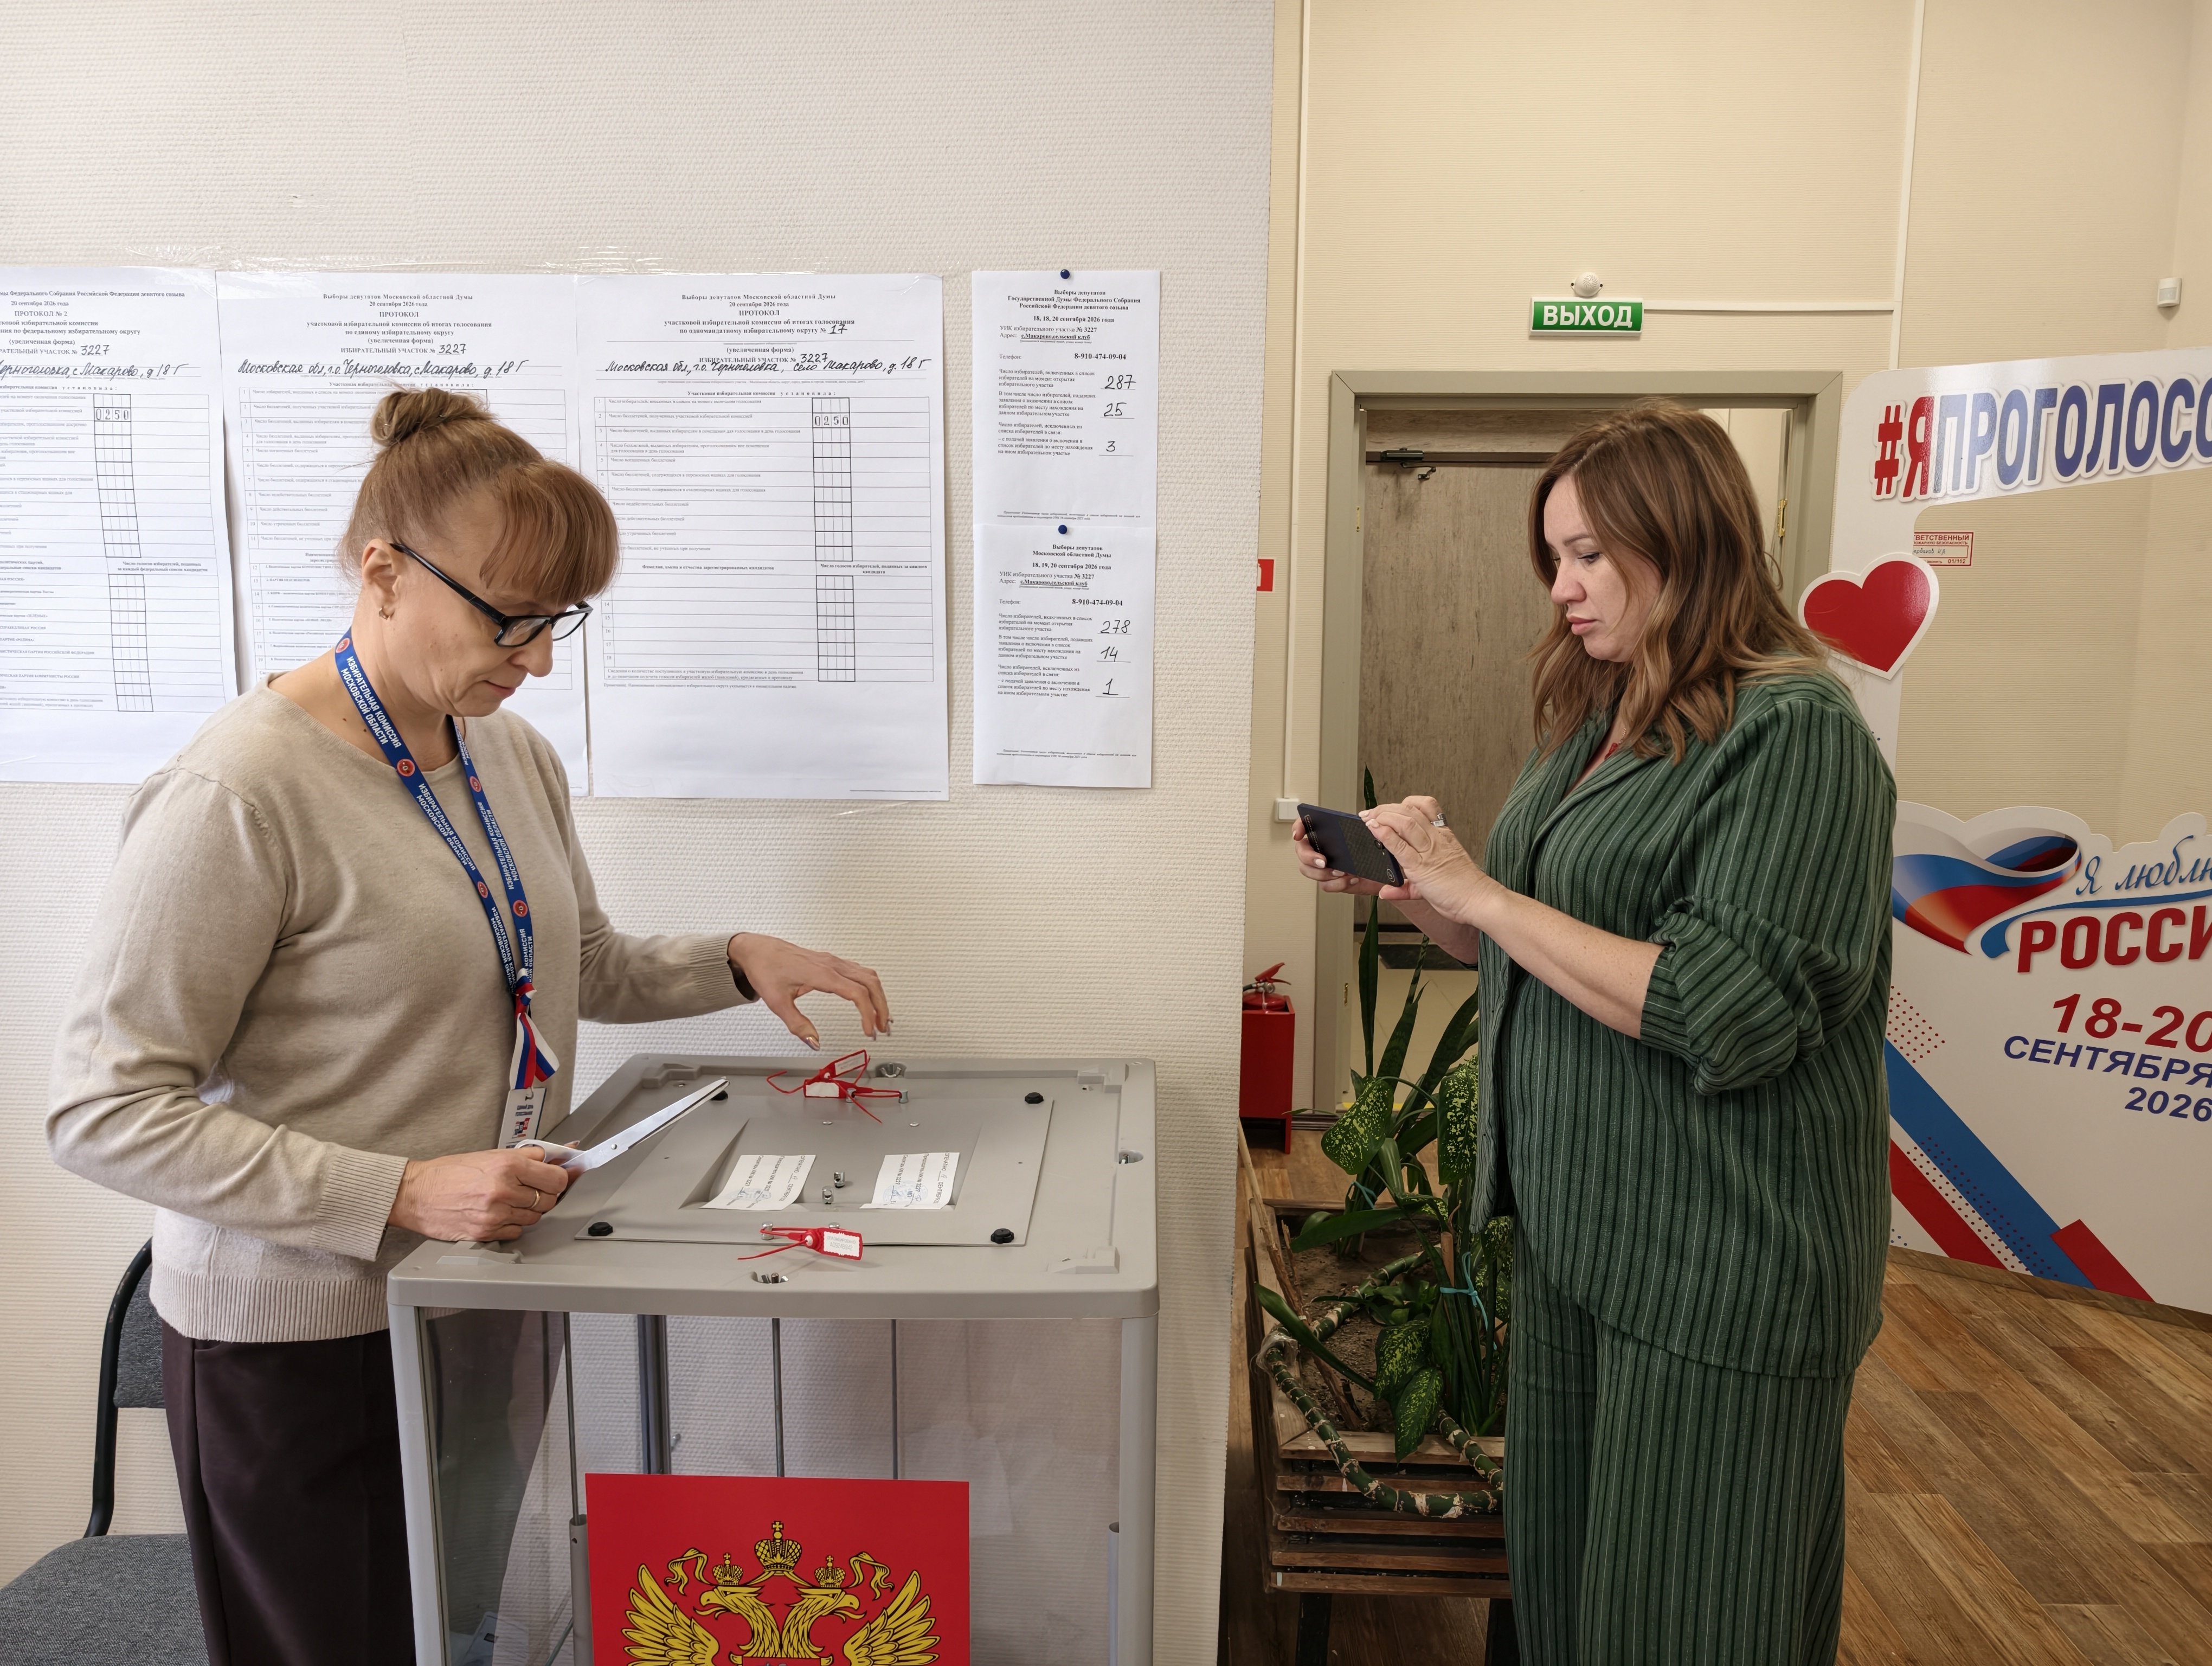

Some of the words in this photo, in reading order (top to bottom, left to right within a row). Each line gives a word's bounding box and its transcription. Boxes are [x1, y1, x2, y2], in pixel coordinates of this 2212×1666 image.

[702, 319, 749, 327] избирательной
[1543, 305, 1632, 328] ВЫХОД
[22, 327, 67, 335] федеральному
[743, 327, 795, 335] избирательному
[829, 324, 848, 335] 17
[999, 332, 1017, 340] Адрес:
[80, 344, 110, 356] 3227
[438, 343, 467, 355] 3227
[800, 353, 828, 363] 3227
[1074, 352, 1126, 360] 8-910-474-09-04
[1104, 374, 1137, 390] 287
[1103, 402, 1127, 417] 25
[1105, 440, 1116, 453] 3
[1071, 598, 1123, 606] 8-910-474-09-04
[1100, 619, 1131, 635] 278
[1101, 646, 1118, 662] 14
[340, 668, 371, 715] МОСКОВСКОЙ
[365, 713, 389, 745] ОБЛАСТИ
[346, 656, 380, 712] ИЗБИРАТЕЛЬНАЯ
[375, 710, 402, 748] КОМИССИЯ
[417, 783, 454, 836] ИЗБИРАТЕЛЬНАЯ
[451, 835, 477, 871] КОМИССИЯ
[477, 802, 496, 836] КОМИССИЯ
[485, 809, 502, 838] ОБЛАСТИ
[416, 794, 450, 838] МОСКОВСКОЙ
[447, 837, 468, 866] ОБЛАСТИ
[491, 837, 515, 890] ИЗБИРАТЕЛЬНАЯ
[498, 837, 519, 881] МОСКОВСКОЙ
[2075, 855, 2103, 896] Я
[519, 928, 530, 967] КОМИССИЯ
[2052, 993, 2212, 1053] 18-20
[2004, 1035, 2212, 1088] СЕНТЯБРЯ
[2124, 1086, 2212, 1123] 2026
